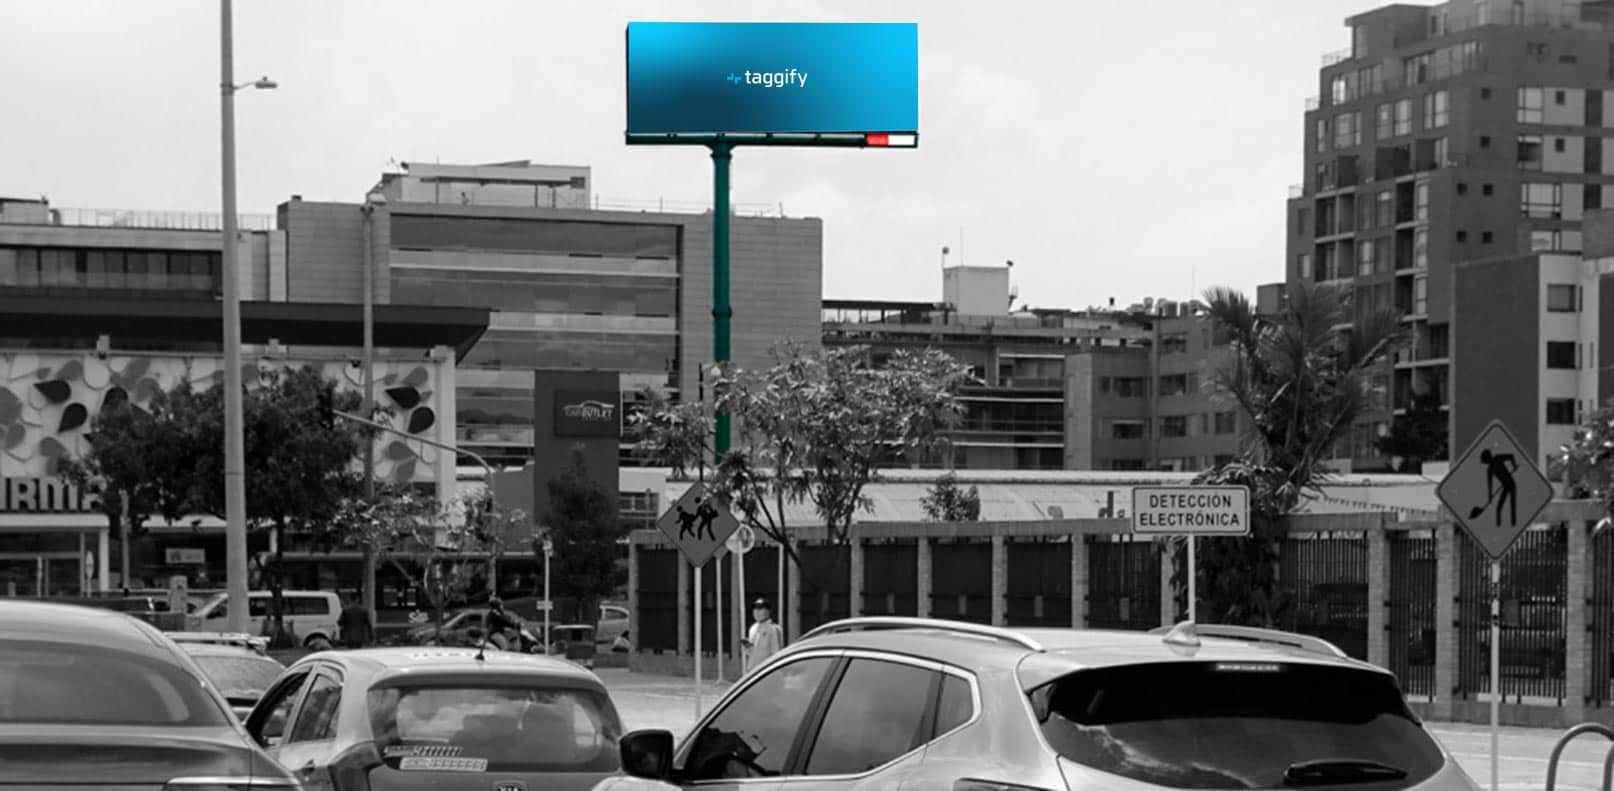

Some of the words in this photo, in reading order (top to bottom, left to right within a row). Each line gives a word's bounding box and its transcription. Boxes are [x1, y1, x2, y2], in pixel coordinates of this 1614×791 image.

[744, 68, 808, 88] taggify
[1149, 492, 1232, 508] DETECCIÓN
[1139, 509, 1240, 526] ELECTRÓNICA
